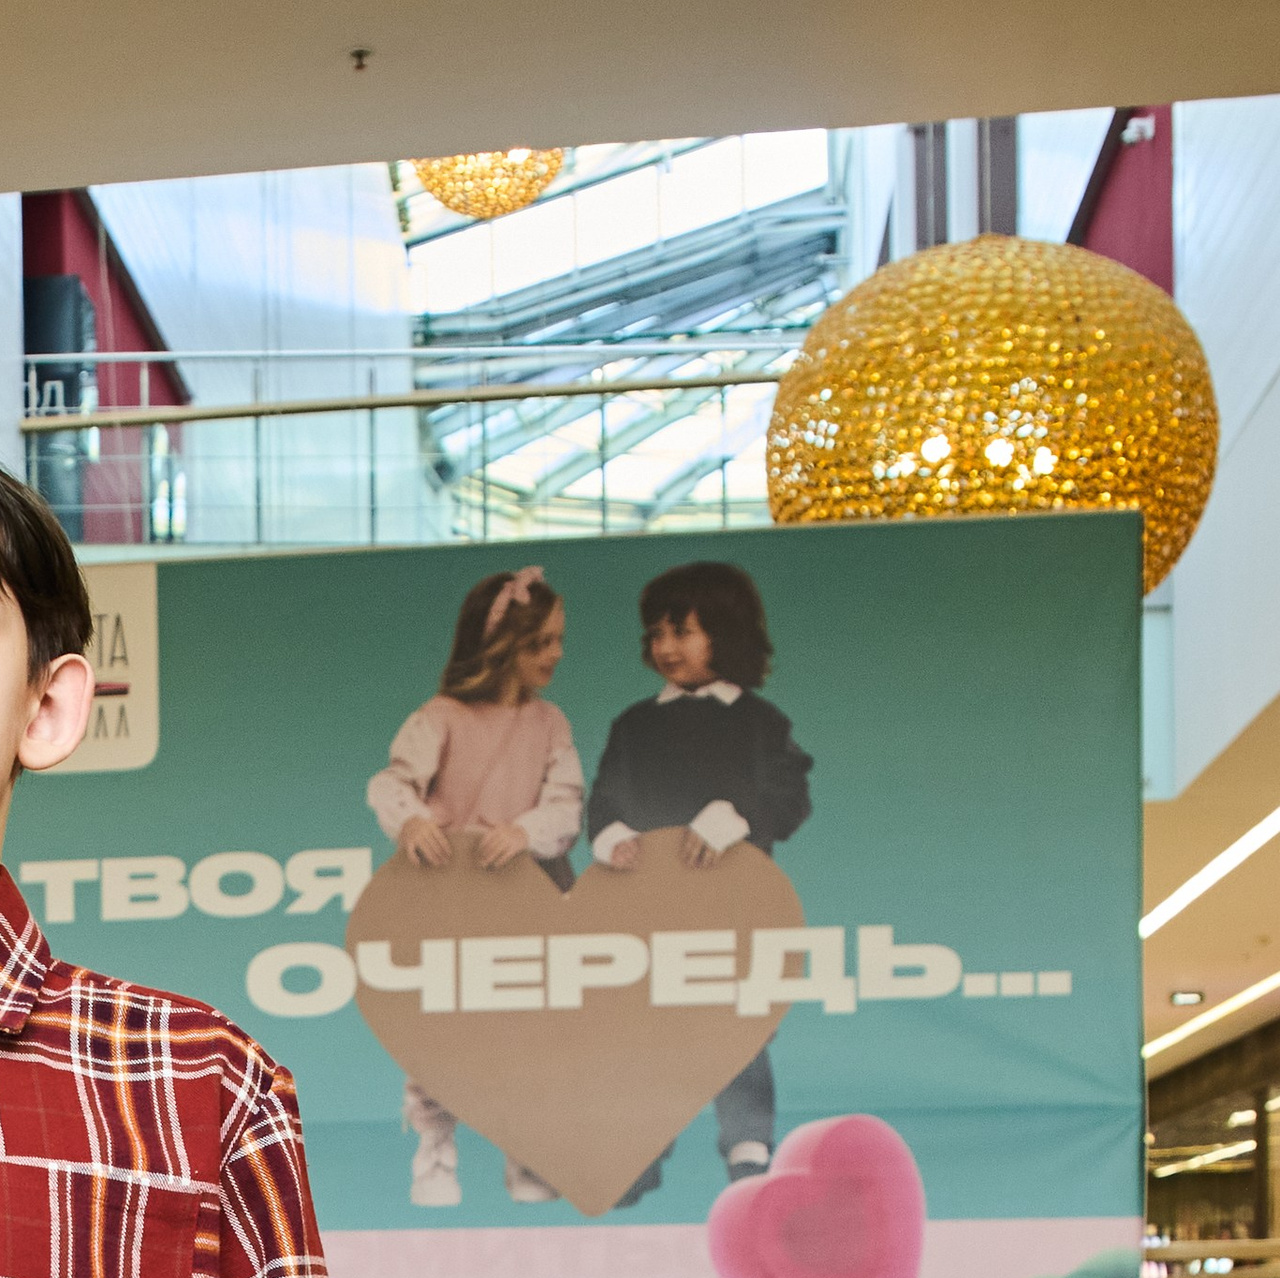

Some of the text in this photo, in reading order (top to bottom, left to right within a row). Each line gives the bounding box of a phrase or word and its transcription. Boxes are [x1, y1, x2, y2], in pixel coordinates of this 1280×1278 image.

[94, 612, 130, 668] ТА
[20, 847, 373, 924] ТВОЯ
[246, 925, 1072, 1017] ОЧЕРЕДЬ...
